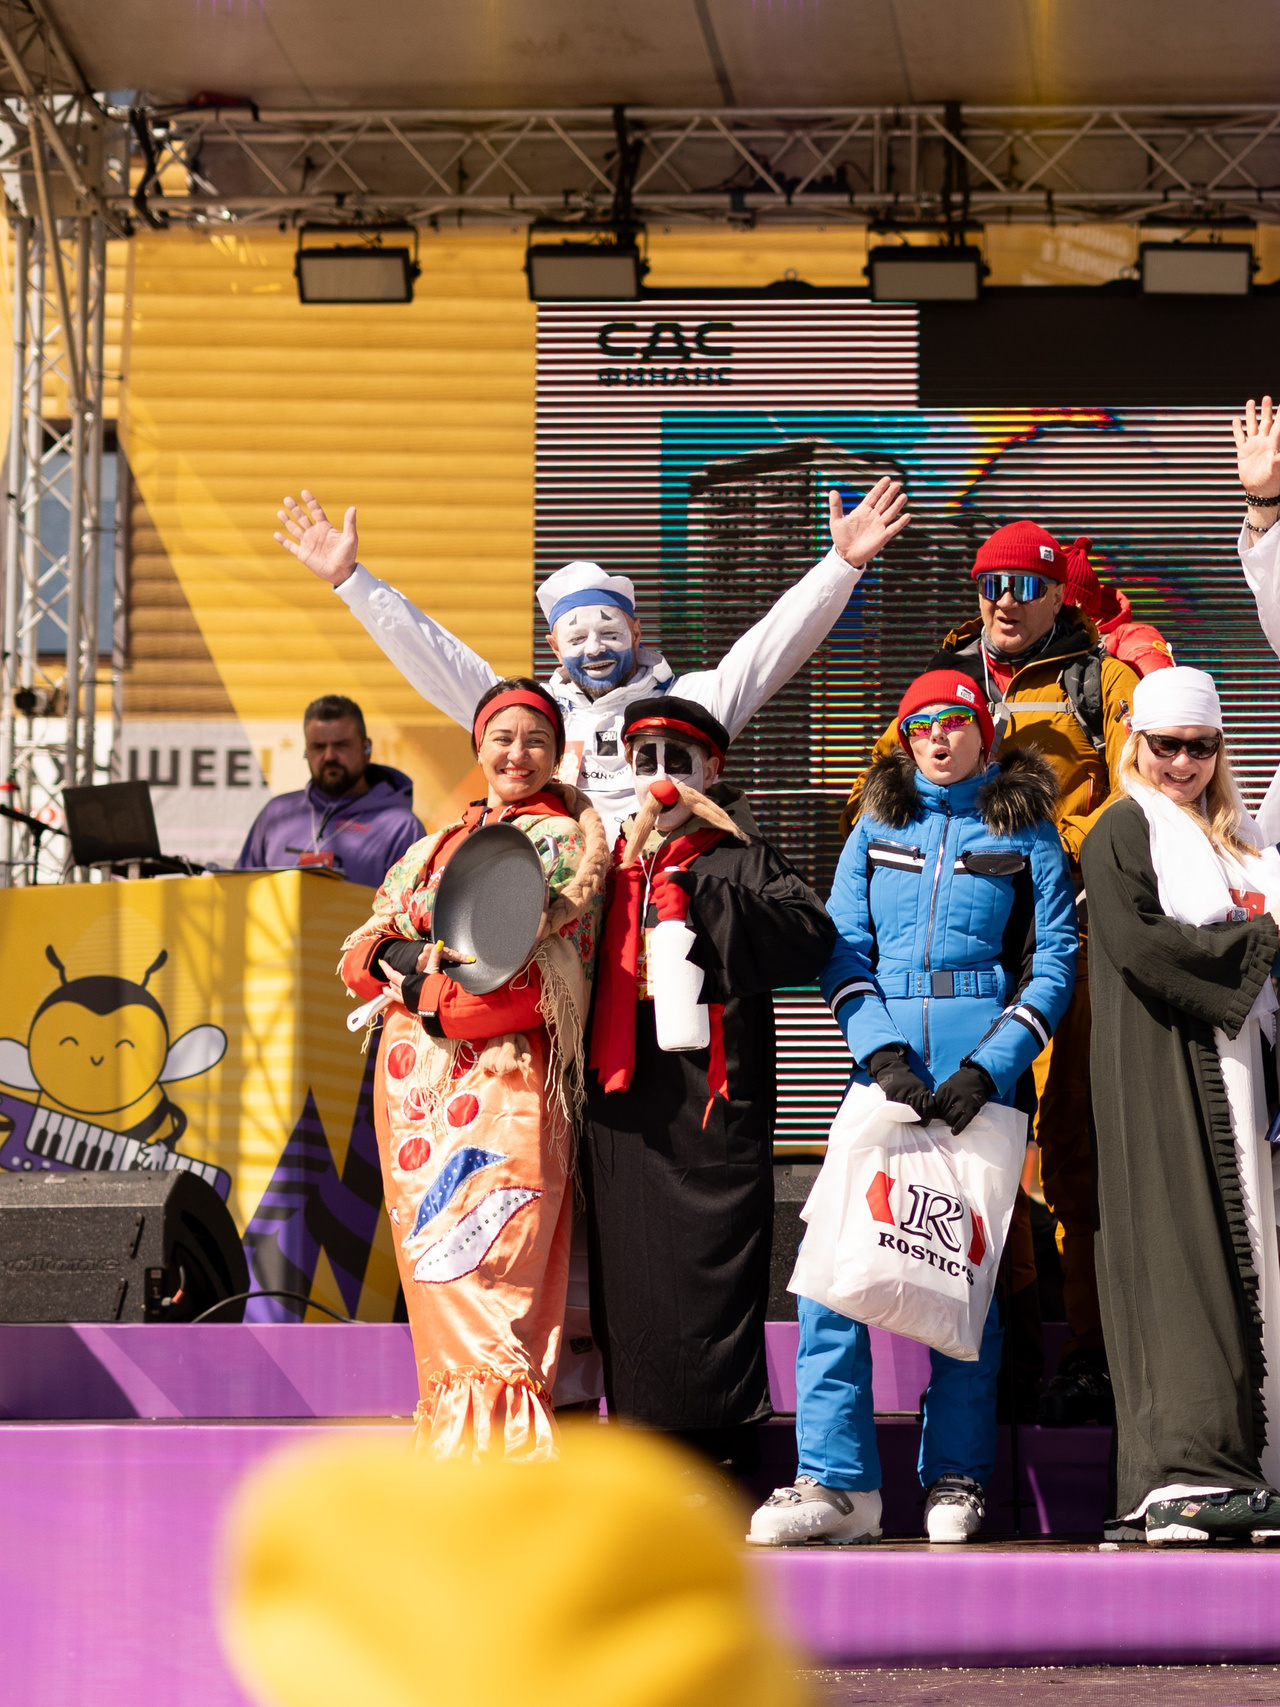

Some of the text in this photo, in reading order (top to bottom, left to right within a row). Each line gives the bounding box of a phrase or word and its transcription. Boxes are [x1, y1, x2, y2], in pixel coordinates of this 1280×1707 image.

[598, 321, 734, 364] СДС
[598, 367, 733, 387] ФИНАНС
[900, 1184, 964, 1253] R
[878, 1232, 975, 1287] ROSTIC'S
